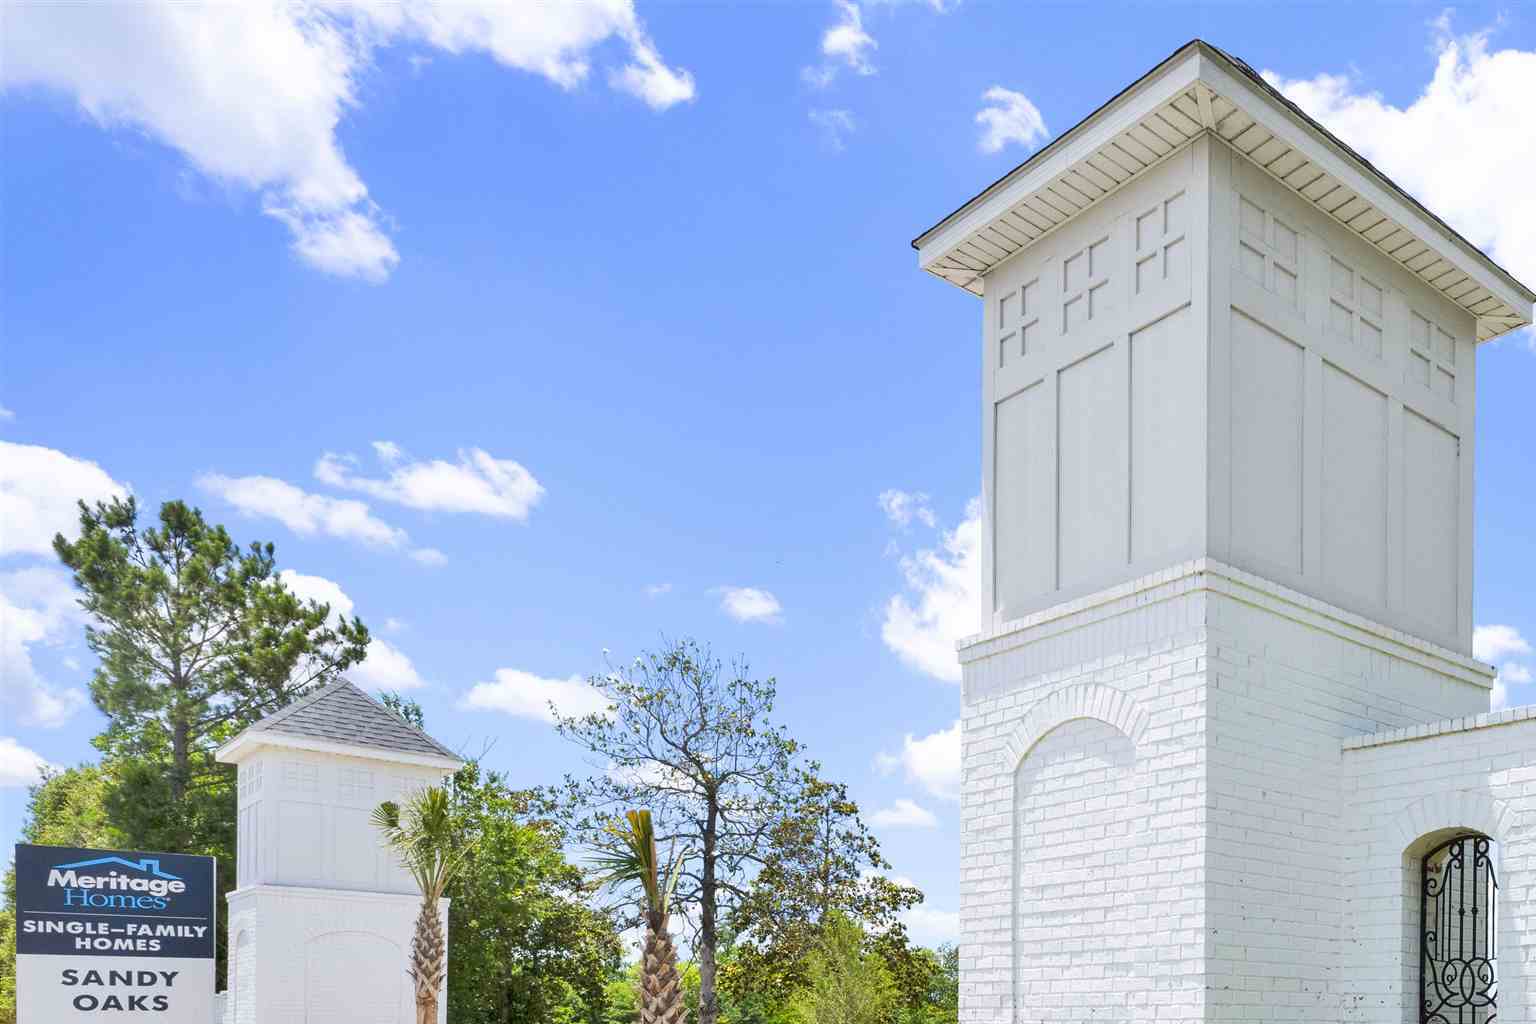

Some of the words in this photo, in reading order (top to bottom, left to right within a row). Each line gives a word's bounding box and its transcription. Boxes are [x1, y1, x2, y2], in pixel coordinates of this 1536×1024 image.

[47, 869, 186, 896] Meritage
[23, 919, 208, 938] SINGLE-FAMILY
[75, 936, 161, 951] HOMES
[61, 968, 179, 987] SANDY
[72, 994, 169, 1012] OAKS
